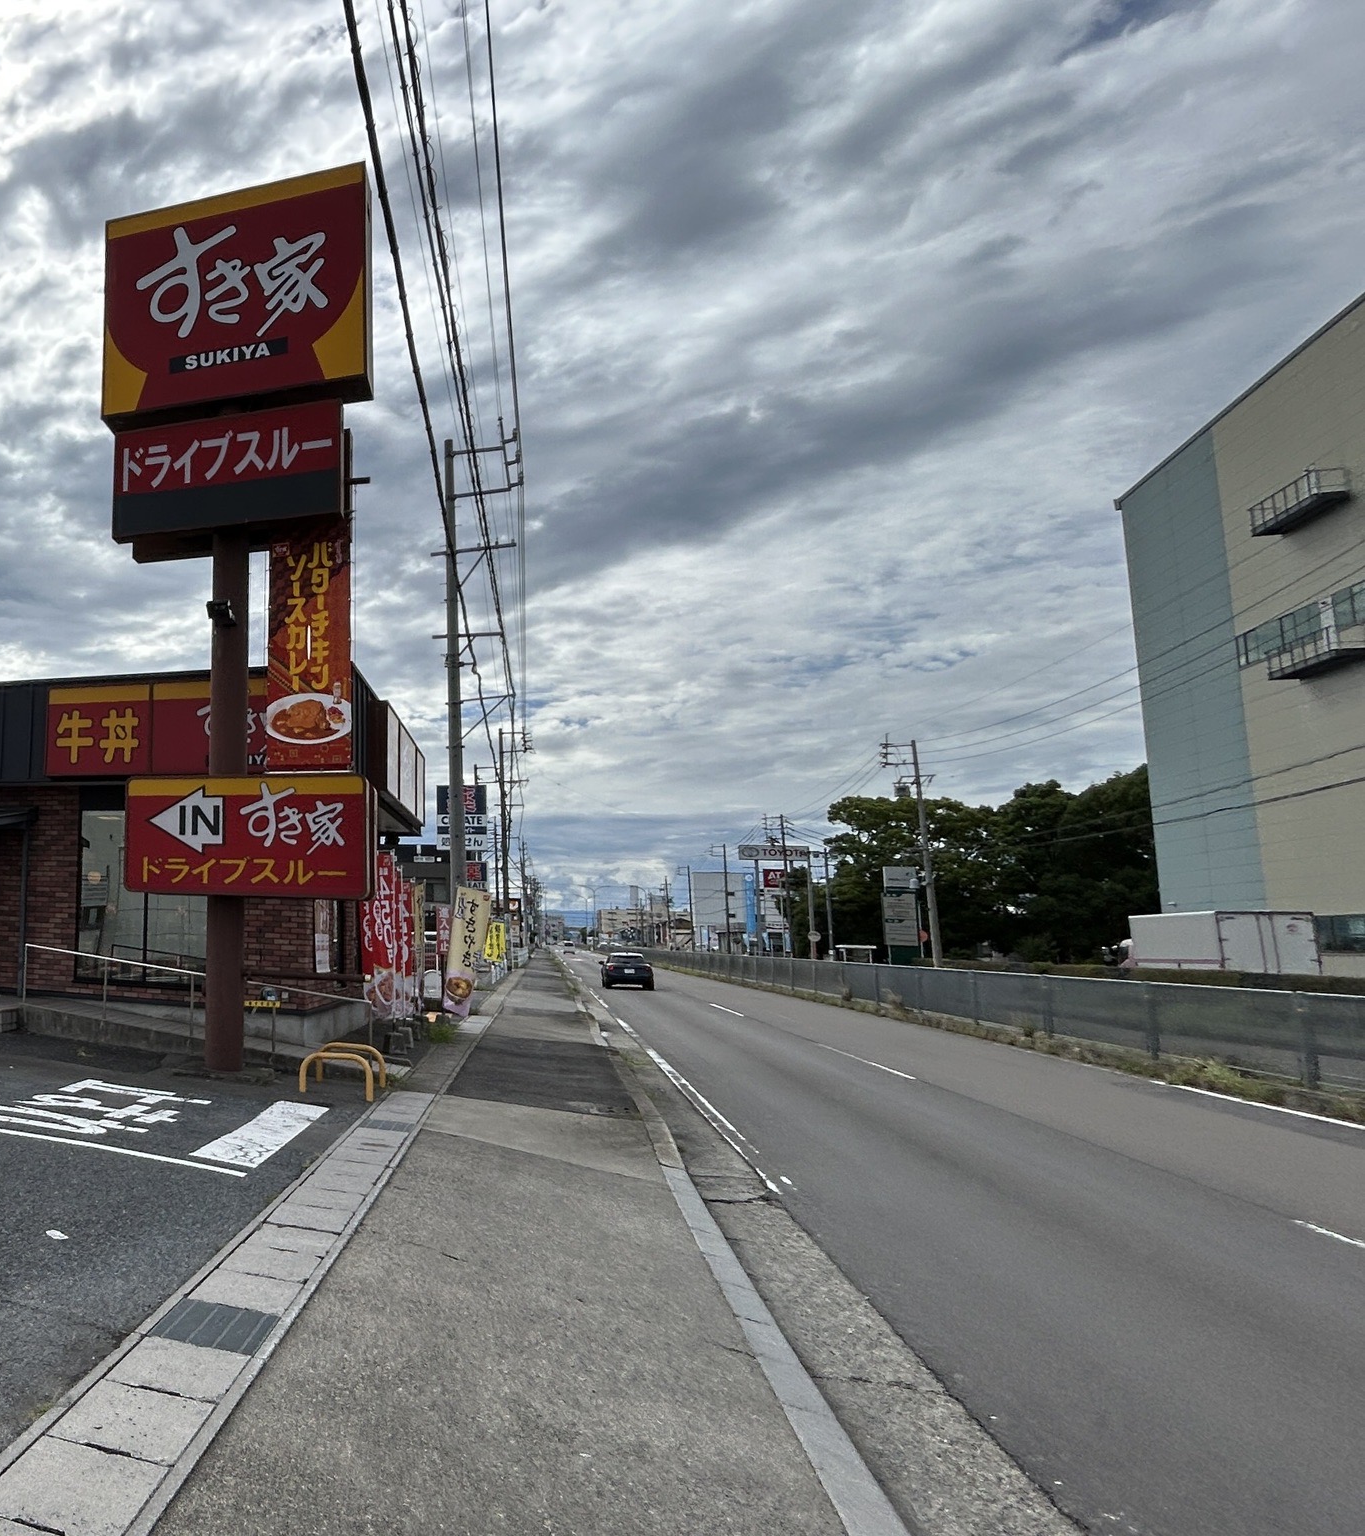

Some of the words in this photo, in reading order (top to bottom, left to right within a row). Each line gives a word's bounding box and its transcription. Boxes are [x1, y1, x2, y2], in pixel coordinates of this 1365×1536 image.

[136, 225, 329, 338] すき家
[184, 341, 271, 371] SUKIYA
[121, 426, 334, 492] ドライブスルー
[285, 553, 308, 692] ソースカレー
[307, 541, 334, 691] バターチキン
[55, 707, 140, 764] 牛丼
[178, 804, 220, 836] IN
[239, 782, 345, 855] すき家
[441, 816, 483, 826] CATE
[441, 836, 483, 848] 処せん
[761, 848, 808, 857] TOYOTA
[141, 856, 347, 886] ドライブスルー
[438, 907, 450, 952] 進入禁止
